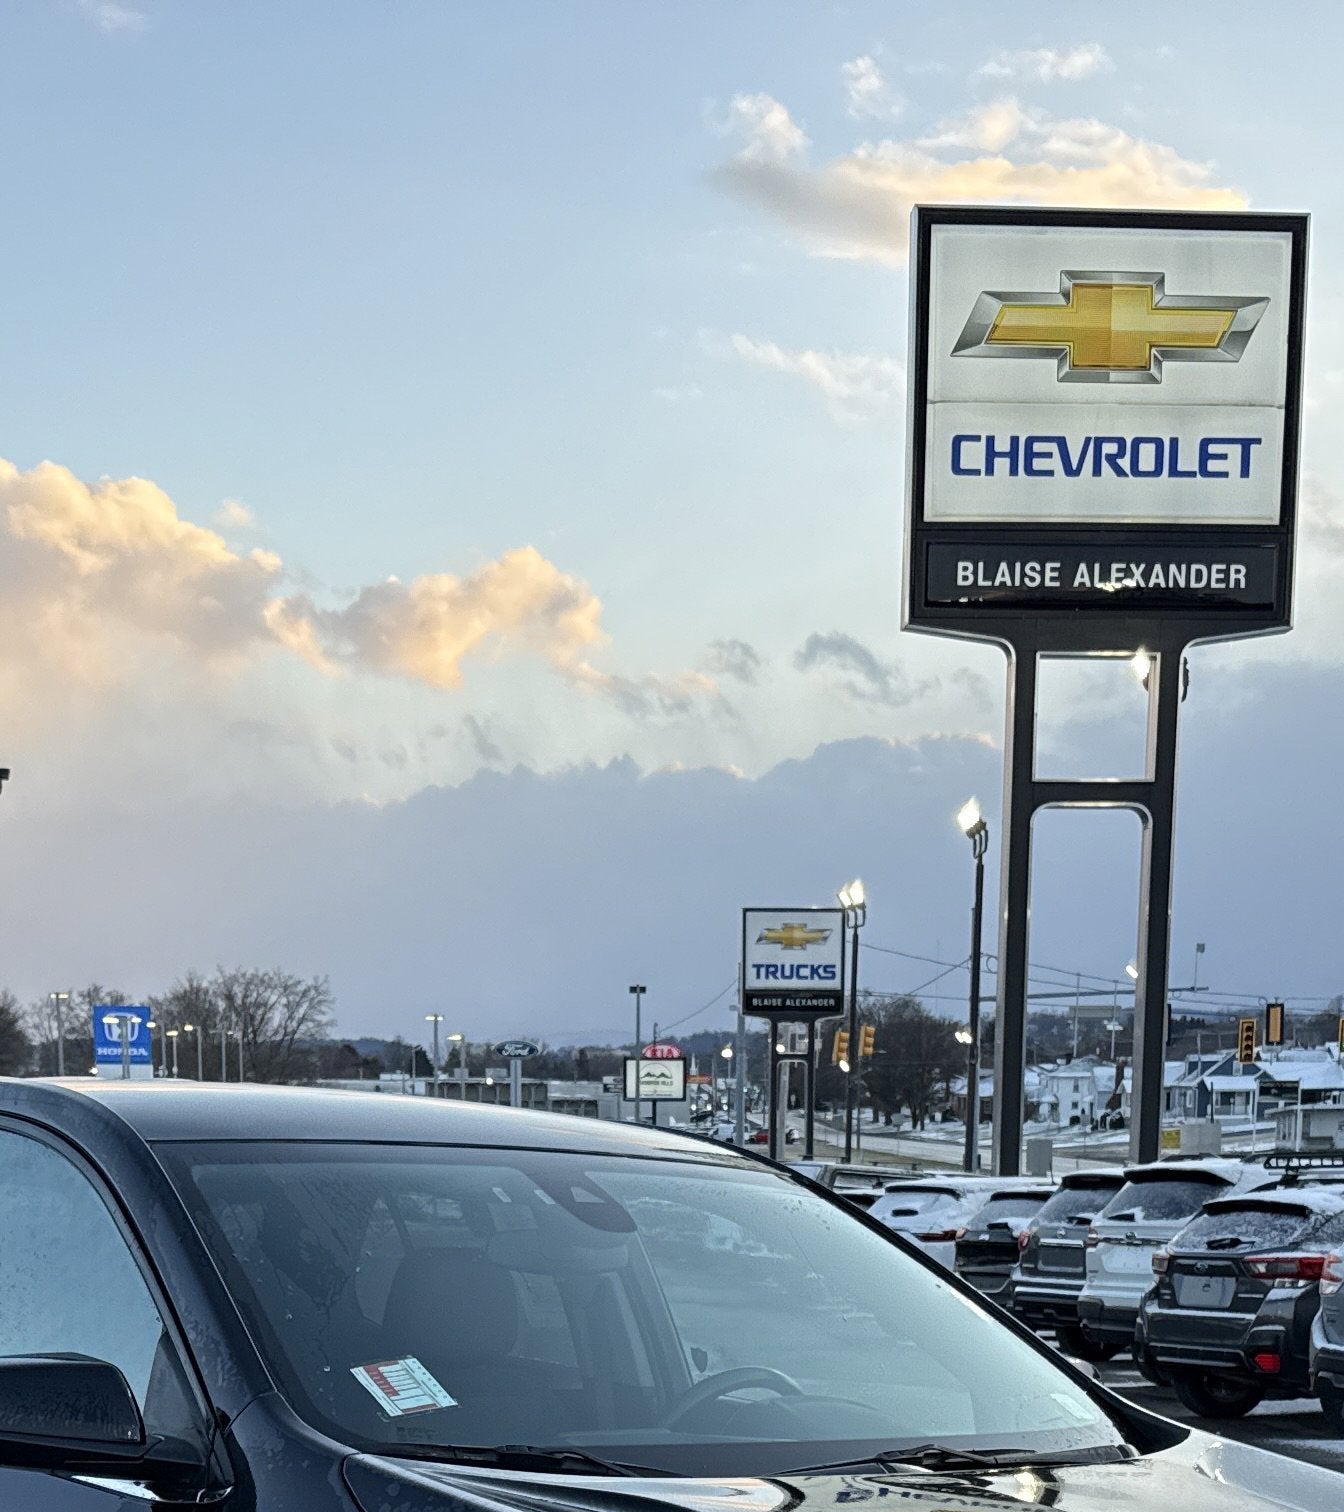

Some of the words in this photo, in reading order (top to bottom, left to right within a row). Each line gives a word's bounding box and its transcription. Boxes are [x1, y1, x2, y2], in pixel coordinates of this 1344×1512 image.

[950, 434, 1262, 479] CHEVROLET
[956, 560, 1061, 588] BLAISE
[1072, 562, 1247, 590] ALEXANDER
[751, 963, 837, 981] TRUCKS
[752, 998, 782, 1007] BLAISE
[785, 998, 835, 1007] ALEXANDER
